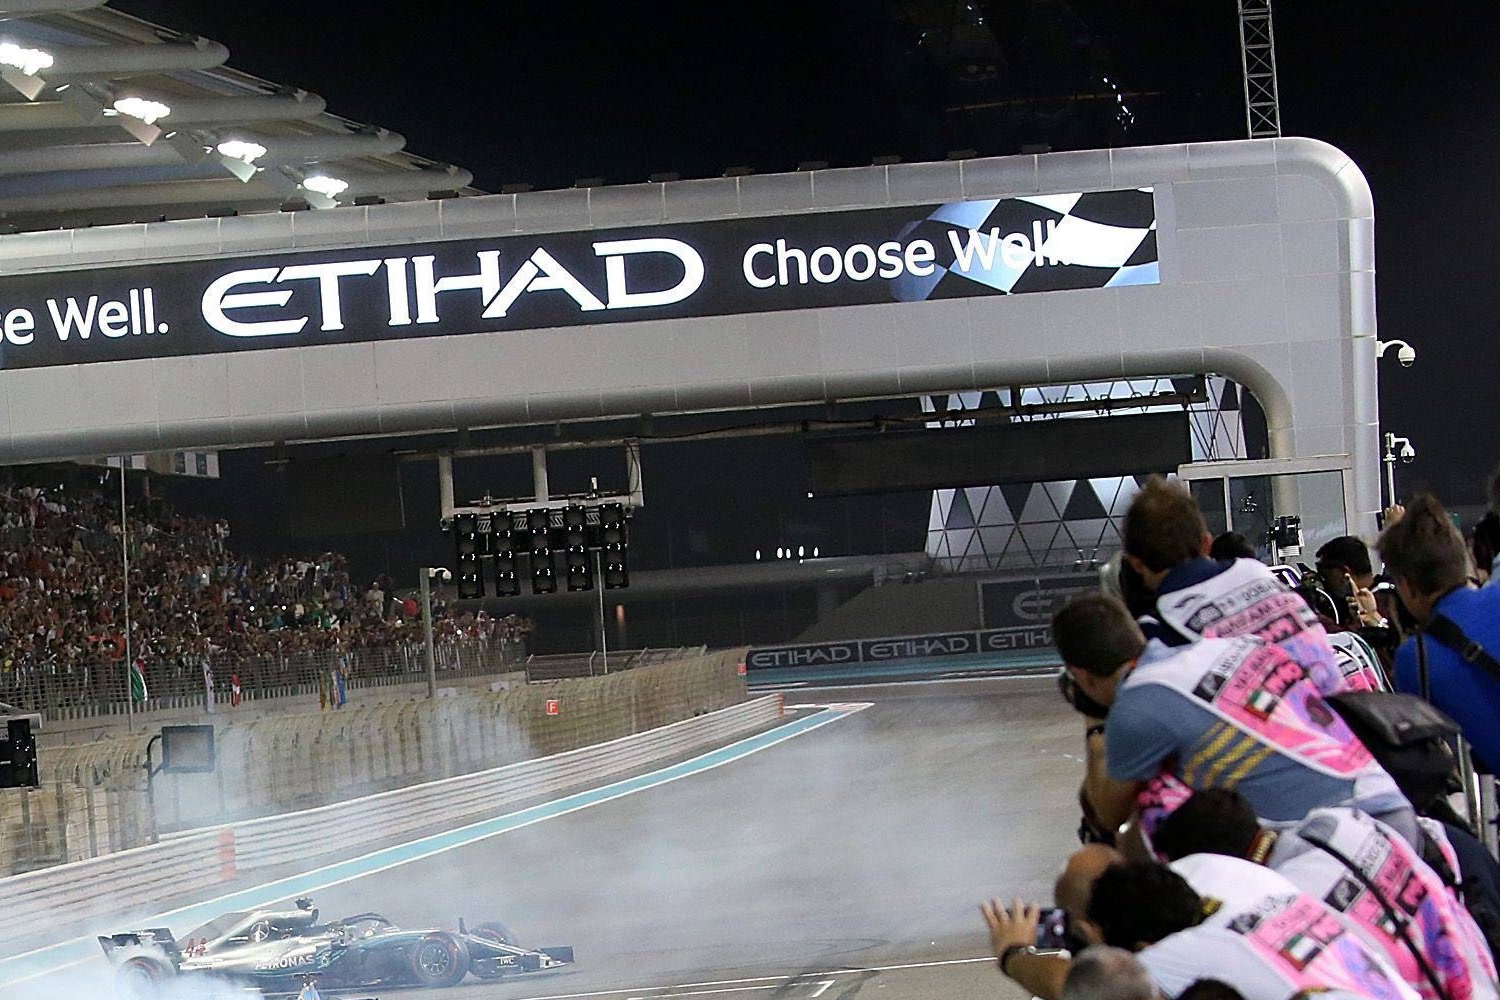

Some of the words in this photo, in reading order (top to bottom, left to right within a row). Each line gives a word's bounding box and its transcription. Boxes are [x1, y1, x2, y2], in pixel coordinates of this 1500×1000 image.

[742, 238, 937, 290] Choose
[201, 237, 705, 338] ETIHAD
[46, 286, 169, 341] Well.
[751, 646, 852, 668] ETIHAD
[869, 637, 970, 658] ETIHAD
[255, 954, 316, 971] PETRONAS
[499, 957, 514, 965] IWC
